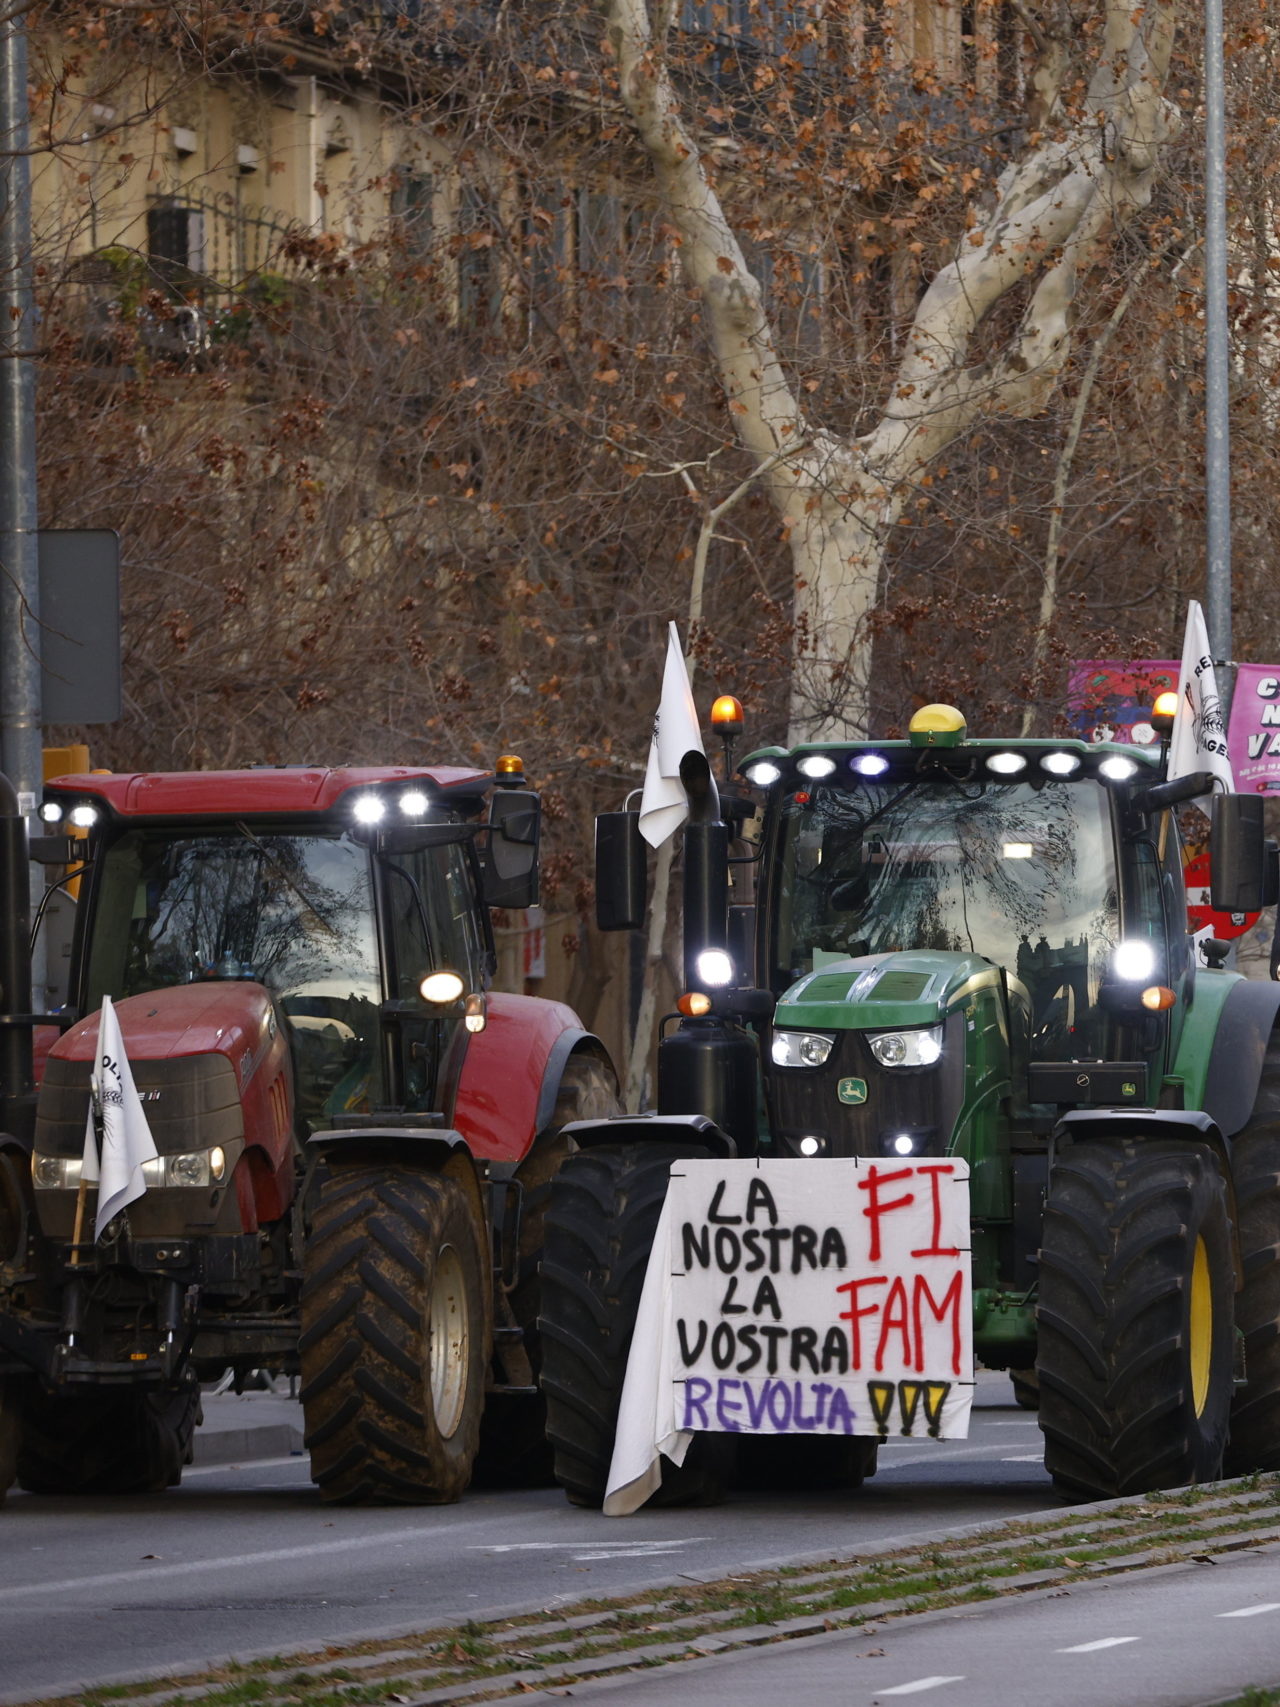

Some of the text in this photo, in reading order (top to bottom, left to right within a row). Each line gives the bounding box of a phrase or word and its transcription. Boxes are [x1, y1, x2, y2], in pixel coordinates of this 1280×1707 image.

[707, 1177, 780, 1226] LA
[858, 1164, 960, 1262] FI
[681, 1221, 848, 1275] NOSTRA
[720, 1275, 782, 1320] LA
[836, 1269, 964, 1376] FAM
[677, 1318, 849, 1375] VOSTRA
[683, 1377, 857, 1435] REVOLTA
